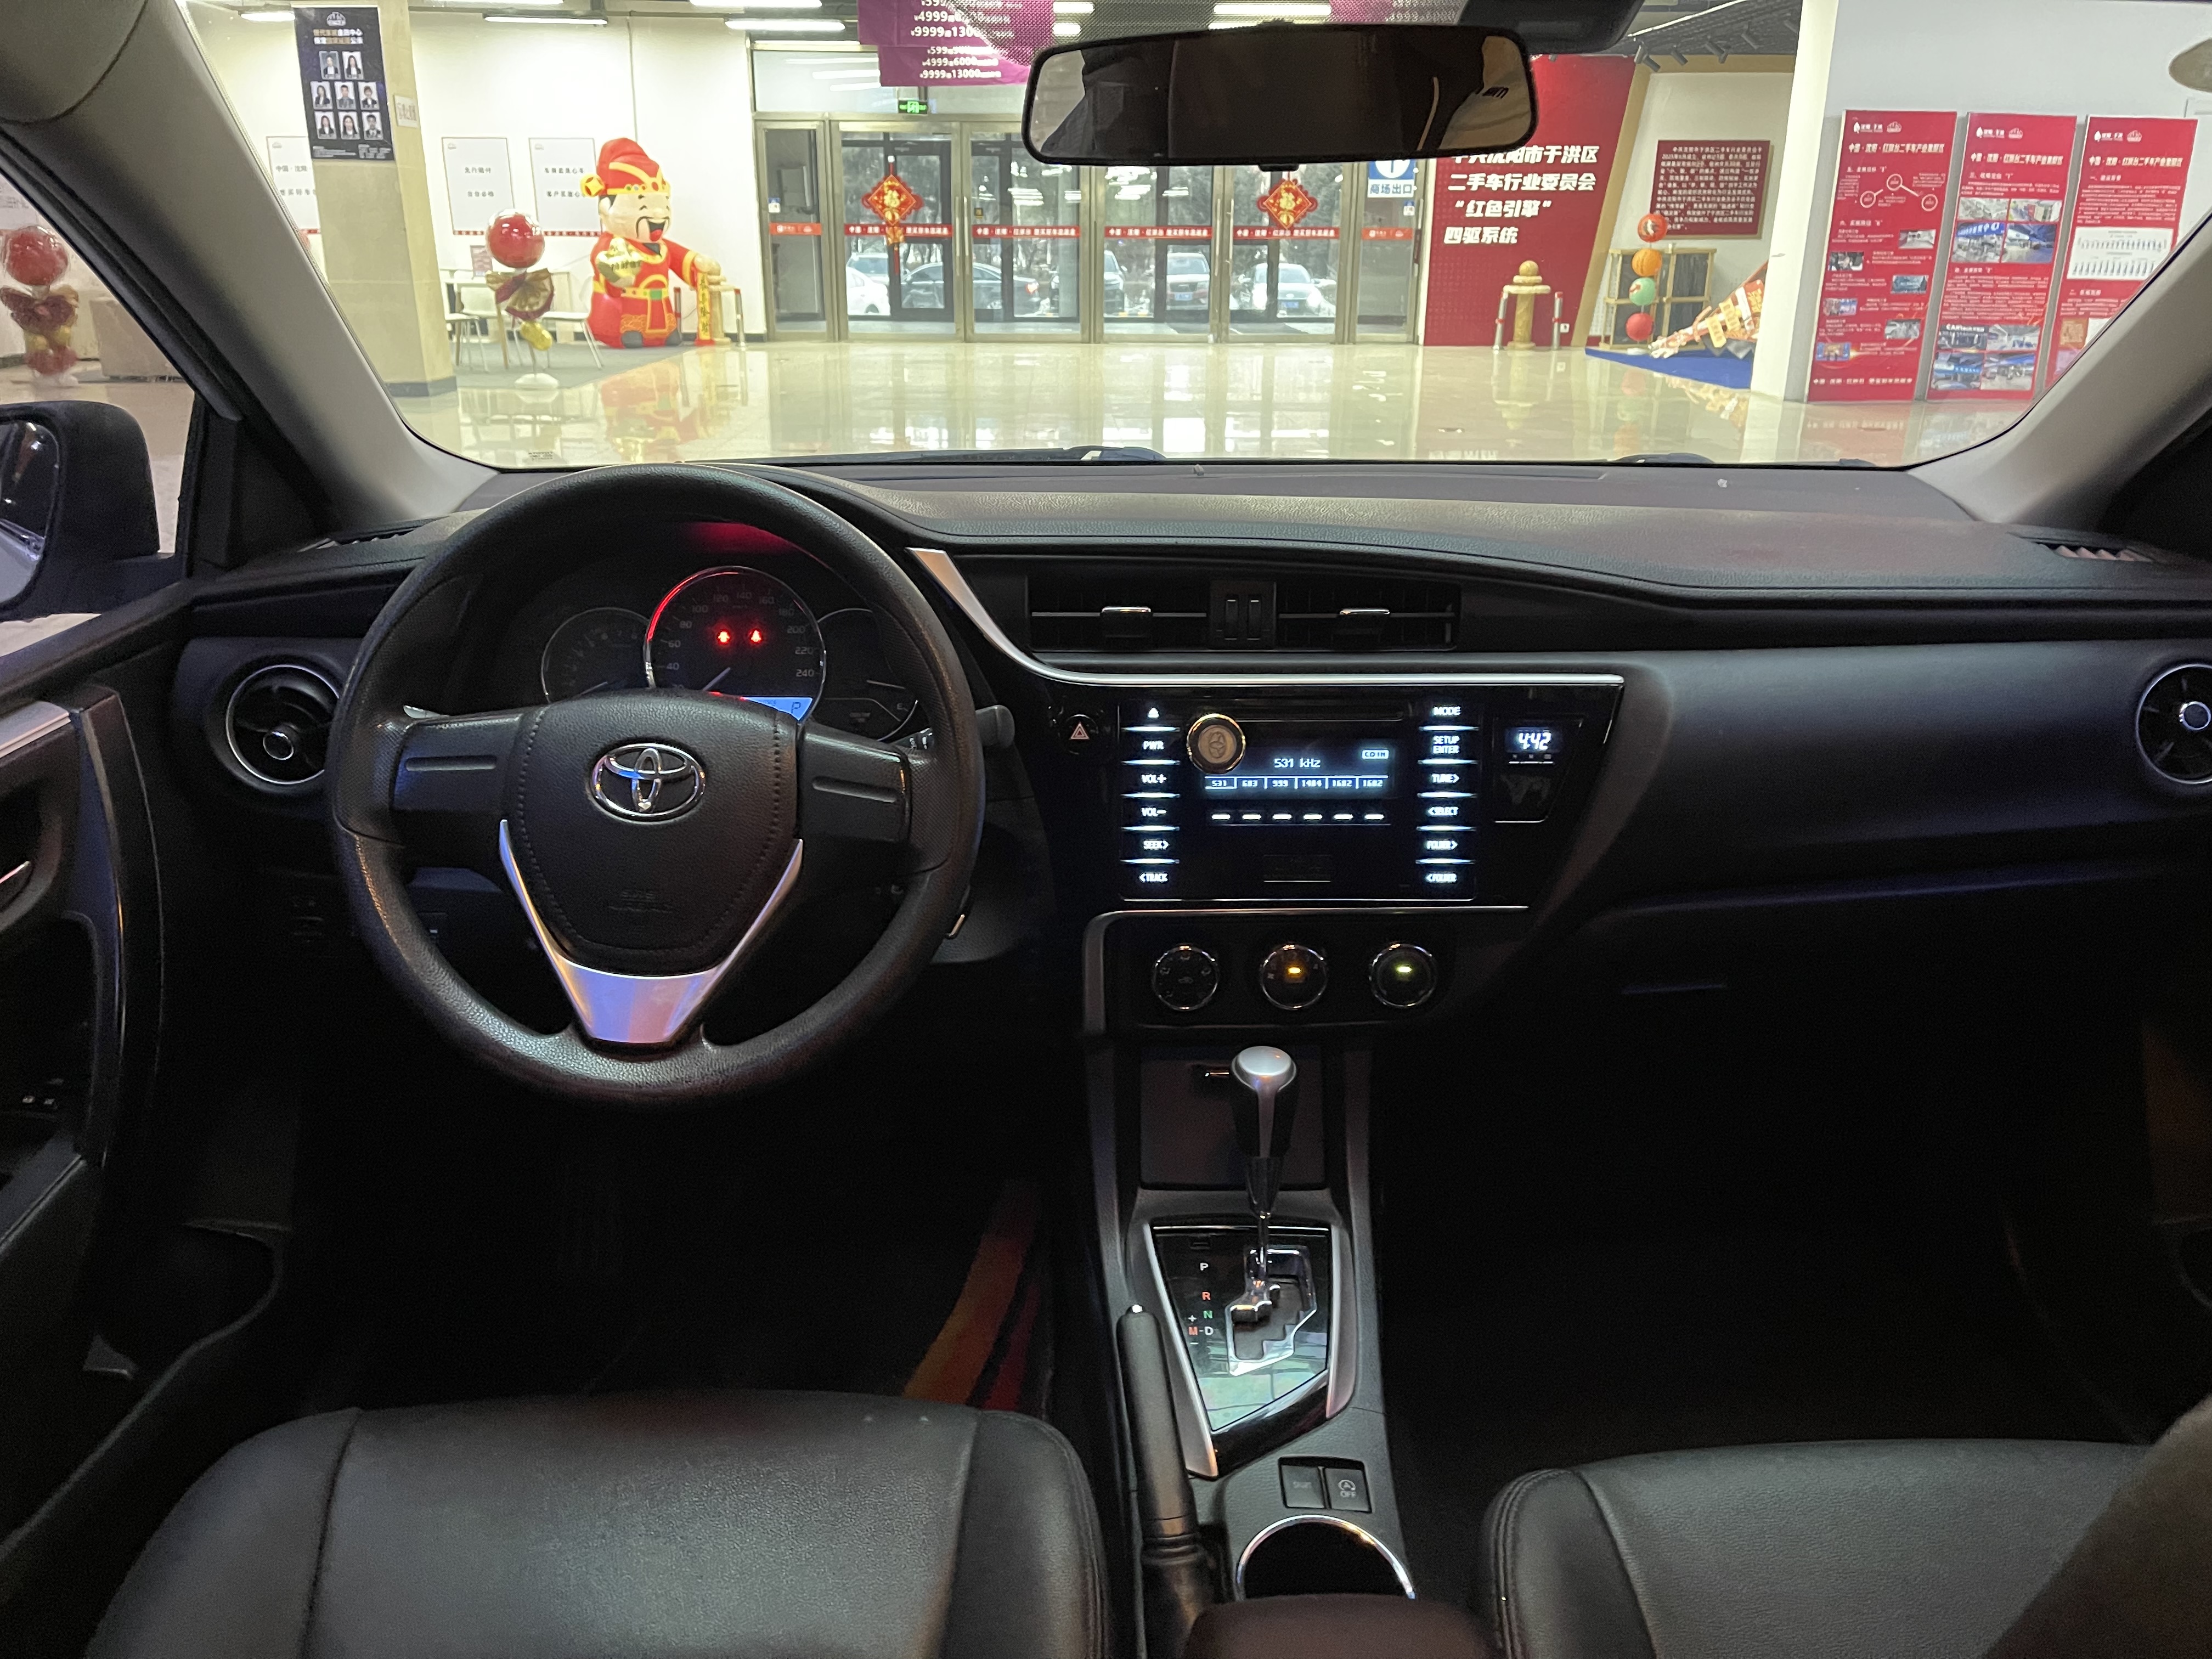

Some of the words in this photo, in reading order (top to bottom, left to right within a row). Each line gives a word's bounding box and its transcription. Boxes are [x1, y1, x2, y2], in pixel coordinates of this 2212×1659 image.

[1448, 172, 1596, 191] 二手车行业委员会
[1370, 184, 1412, 194] 商场出口
[1443, 227, 1519, 244] 四驱系统
[692, 605, 708, 613] 100
[679, 620, 693, 629] 80
[787, 625, 806, 634] 200
[668, 640, 681, 648] 60
[795, 646, 814, 655] 220
[667, 662, 680, 670] 40
[796, 669, 815, 678] 240
[791, 702, 802, 714] P
[1433, 706, 1461, 716] MODE
[1433, 735, 1460, 744] SETUP
[1519, 732, 1551, 750] 4:42
[1143, 741, 1164, 750] PWR
[1433, 744, 1459, 754] ENTER
[1274, 758, 1294, 768] 531
[1300, 758, 1321, 768] kHz
[1199, 1262, 1209, 1271] P
[1201, 1291, 1211, 1301] R
[1203, 1310, 1213, 1319] N
